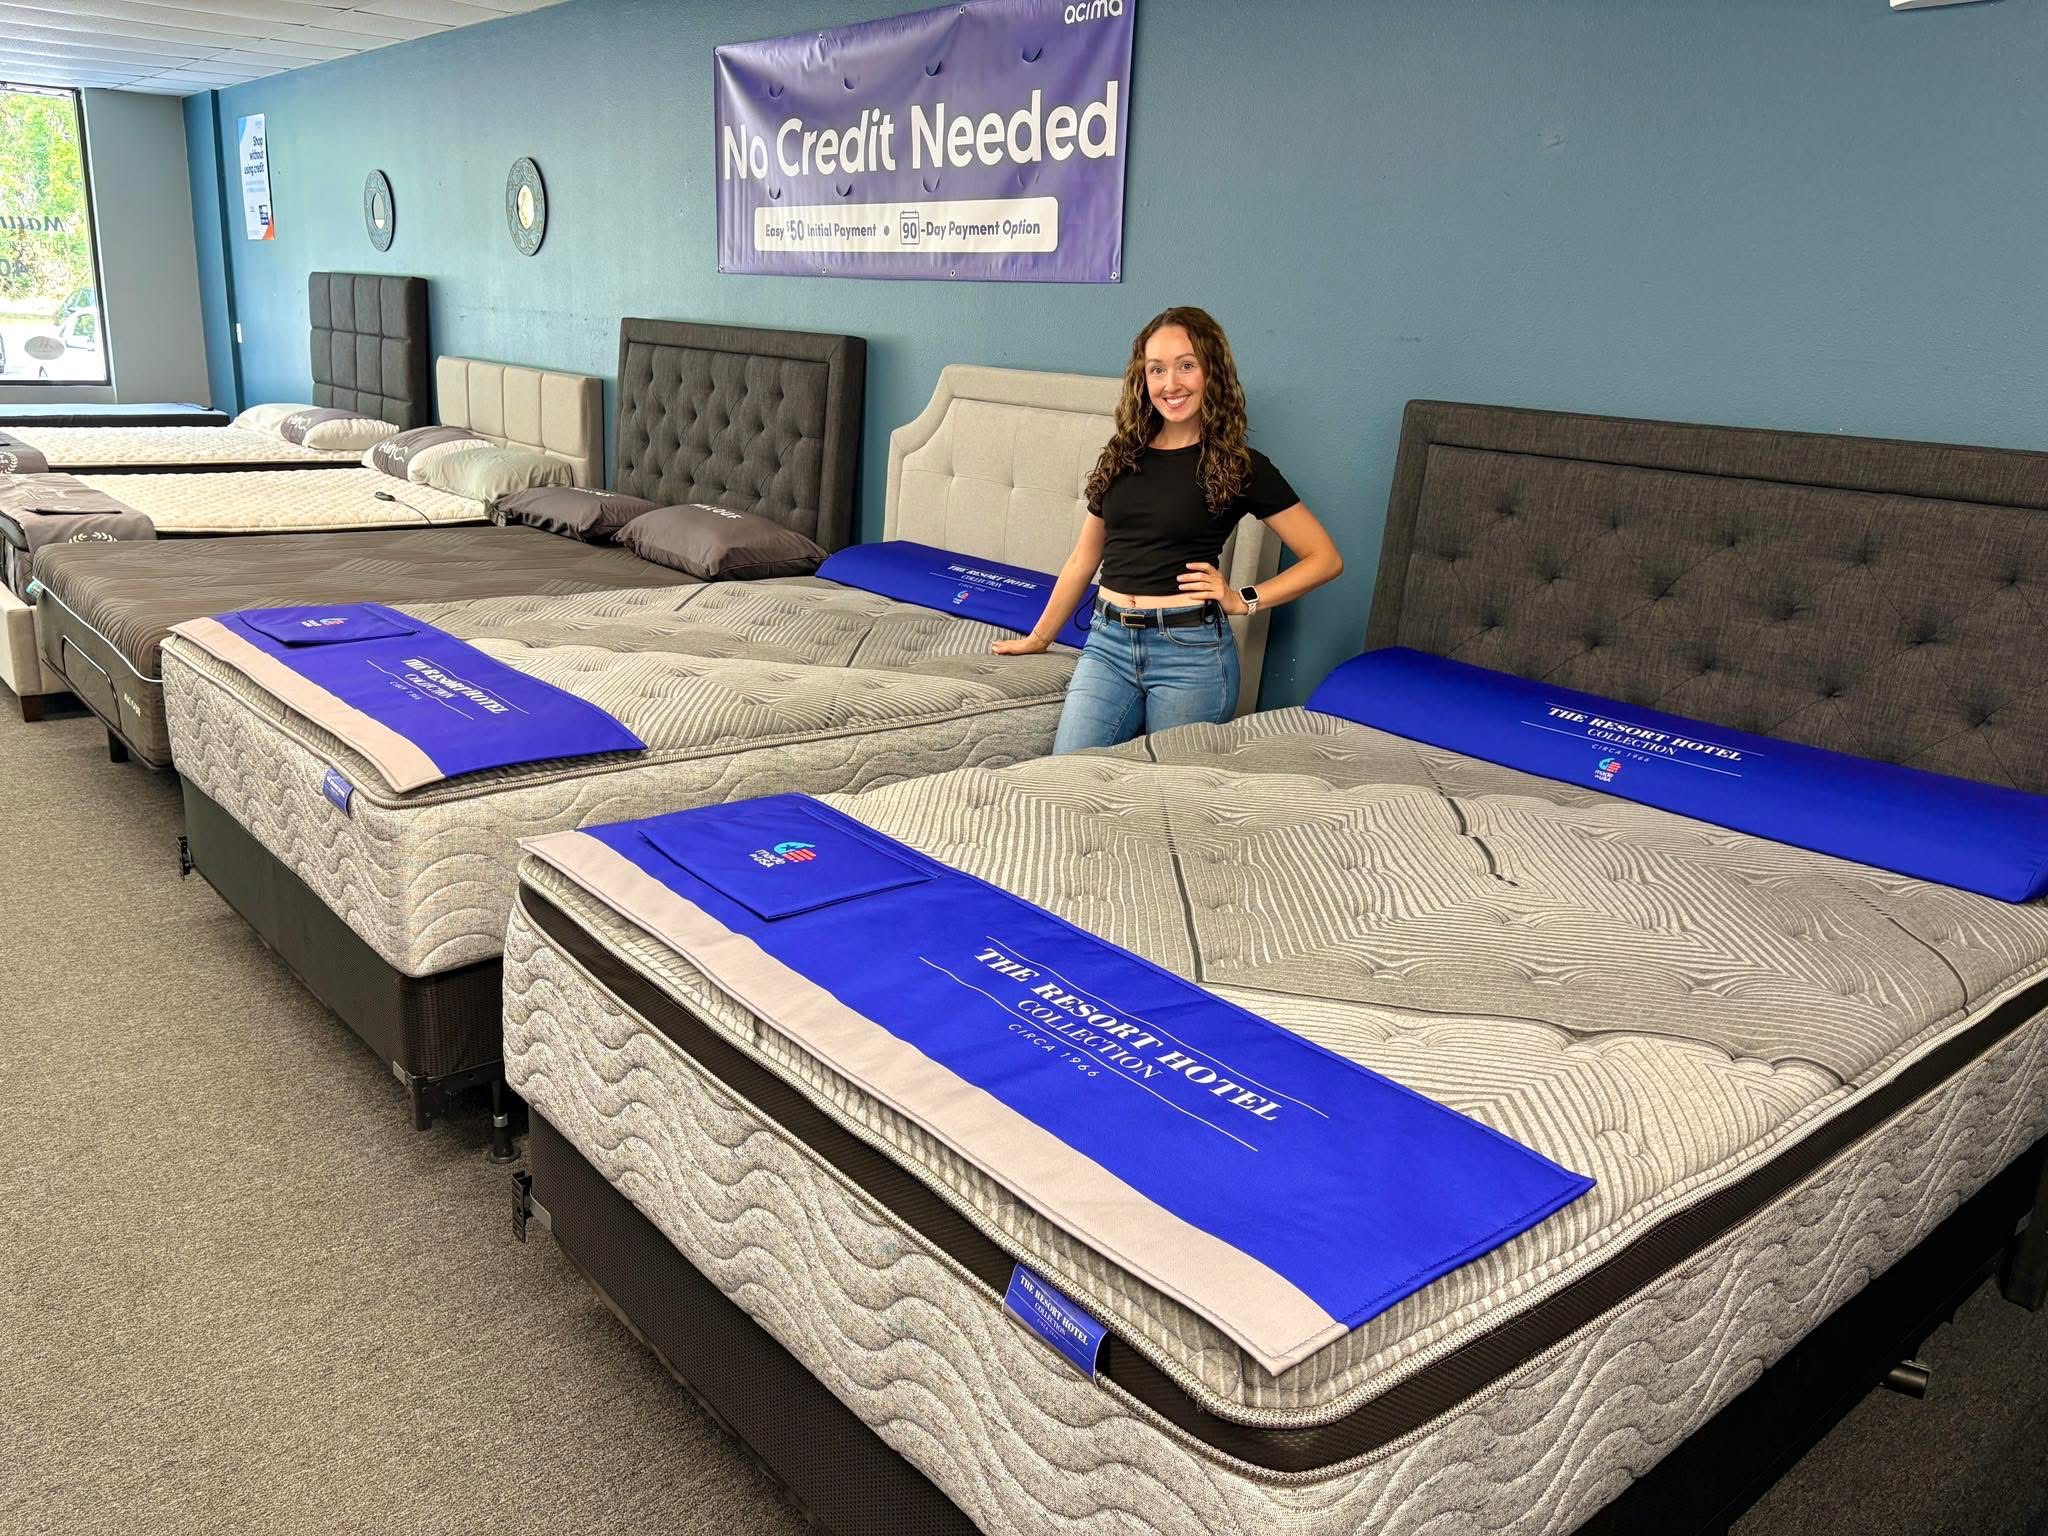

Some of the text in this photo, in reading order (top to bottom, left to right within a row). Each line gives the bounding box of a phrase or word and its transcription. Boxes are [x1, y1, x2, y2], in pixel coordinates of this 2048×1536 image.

[1064, 0, 1122, 24] acima
[253, 136, 263, 147] Shop
[723, 81, 1119, 180] No Credit Needed
[249, 150, 264, 160] without
[244, 163, 264, 176] using credit
[765, 225, 784, 239] Easy
[787, 219, 804, 240] $50
[807, 223, 832, 238] Initial
[834, 224, 876, 240] Payment
[949, 221, 999, 239] Payment
[1002, 220, 1040, 240] Option
[461, 690, 509, 713] HOTEL
[1548, 707, 1744, 762] THE RESORT HOTEL
[1587, 728, 1677, 756] COLLECTION
[1592, 744, 1622, 754] CIRCA
[974, 948, 1283, 1121] THE RESORT HOTEL
[1017, 1000, 1163, 1078] COLLECTION
[1008, 1023, 1100, 1077] CIRCA 1966
[1020, 1275, 1088, 1345] THE RESORT HOTEL
[1034, 1302, 1067, 1336] COLLECTION
